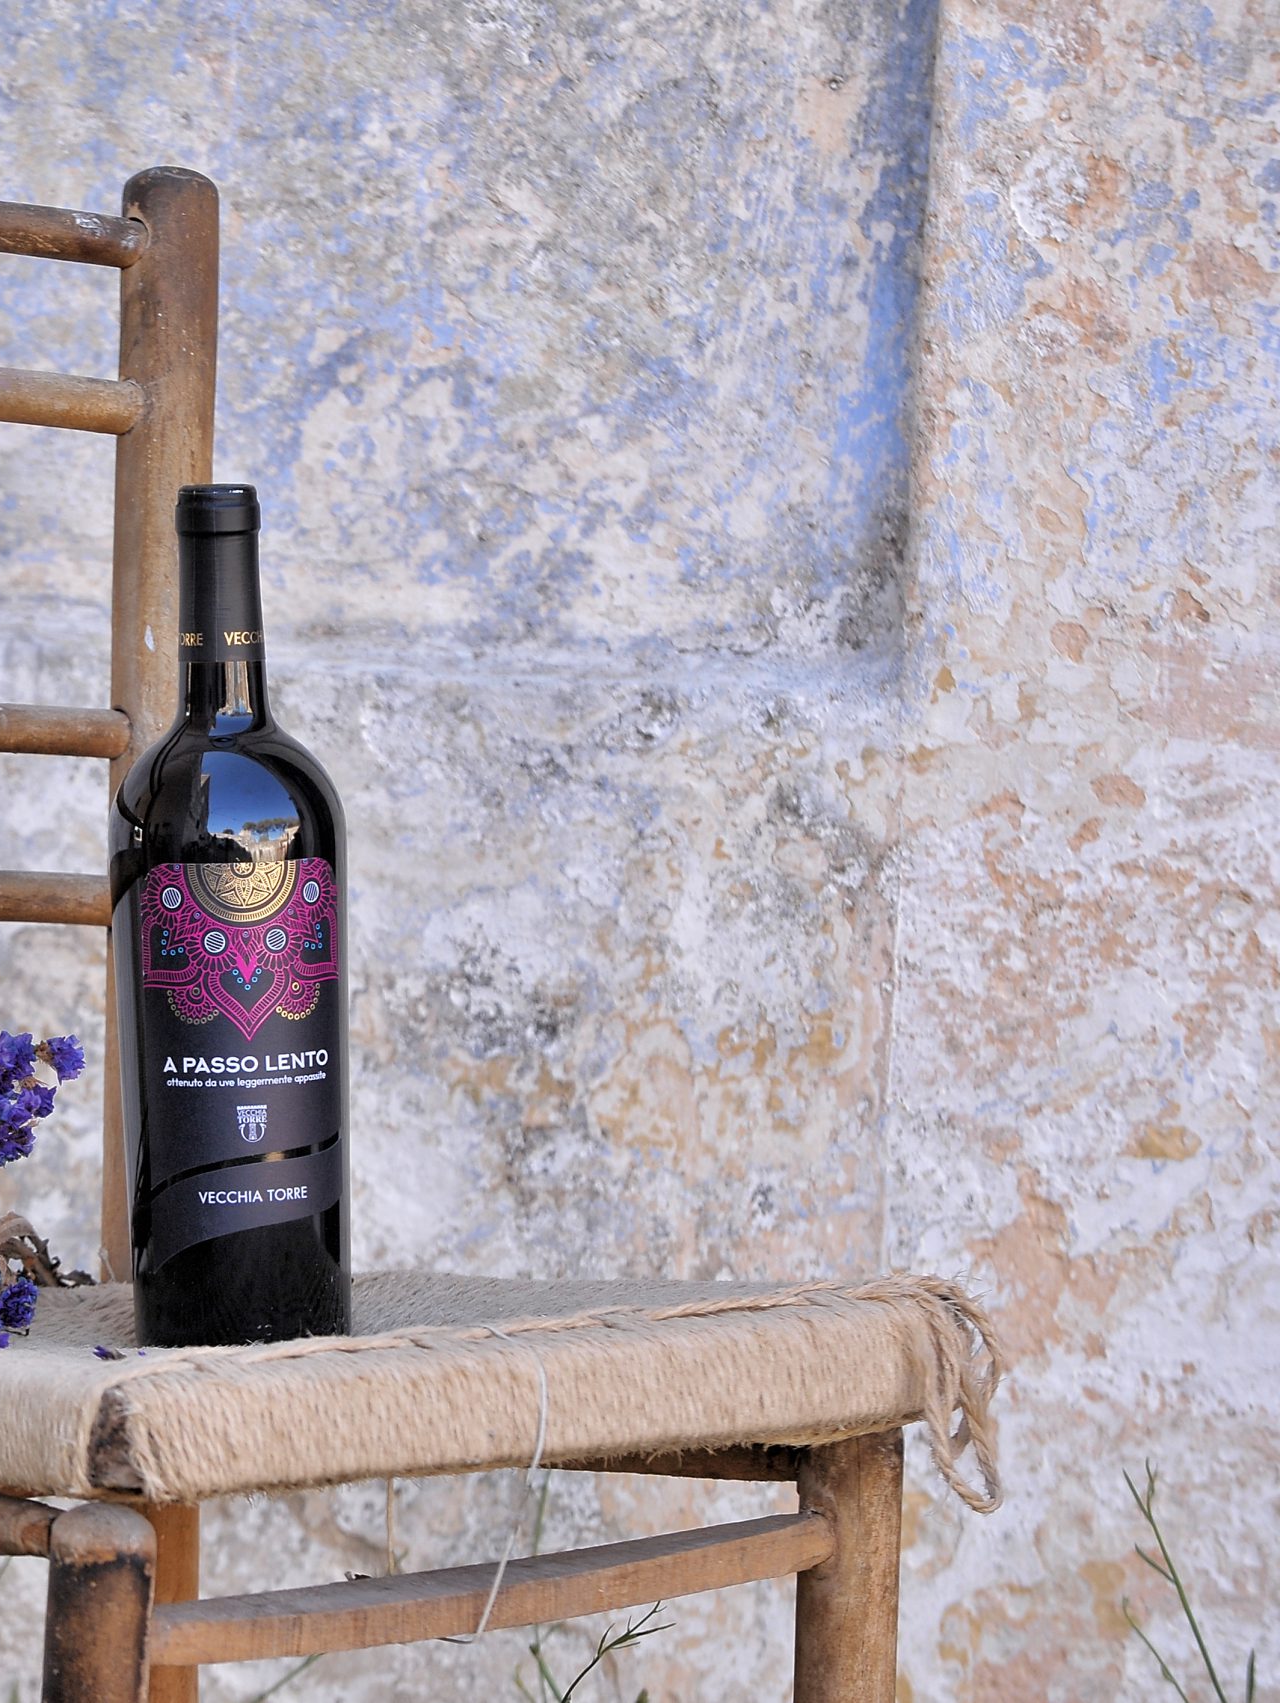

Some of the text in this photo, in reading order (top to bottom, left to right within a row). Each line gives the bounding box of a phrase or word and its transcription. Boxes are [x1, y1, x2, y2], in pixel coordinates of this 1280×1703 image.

[179, 631, 263, 647] ORRE VECCH
[163, 1049, 328, 1074] A PASSO LENTO
[166, 1071, 326, 1088] ottenuto da uve leggermente appassite
[237, 1115, 268, 1124] TORRE
[198, 1185, 308, 1204] VECCHIA TORRE
